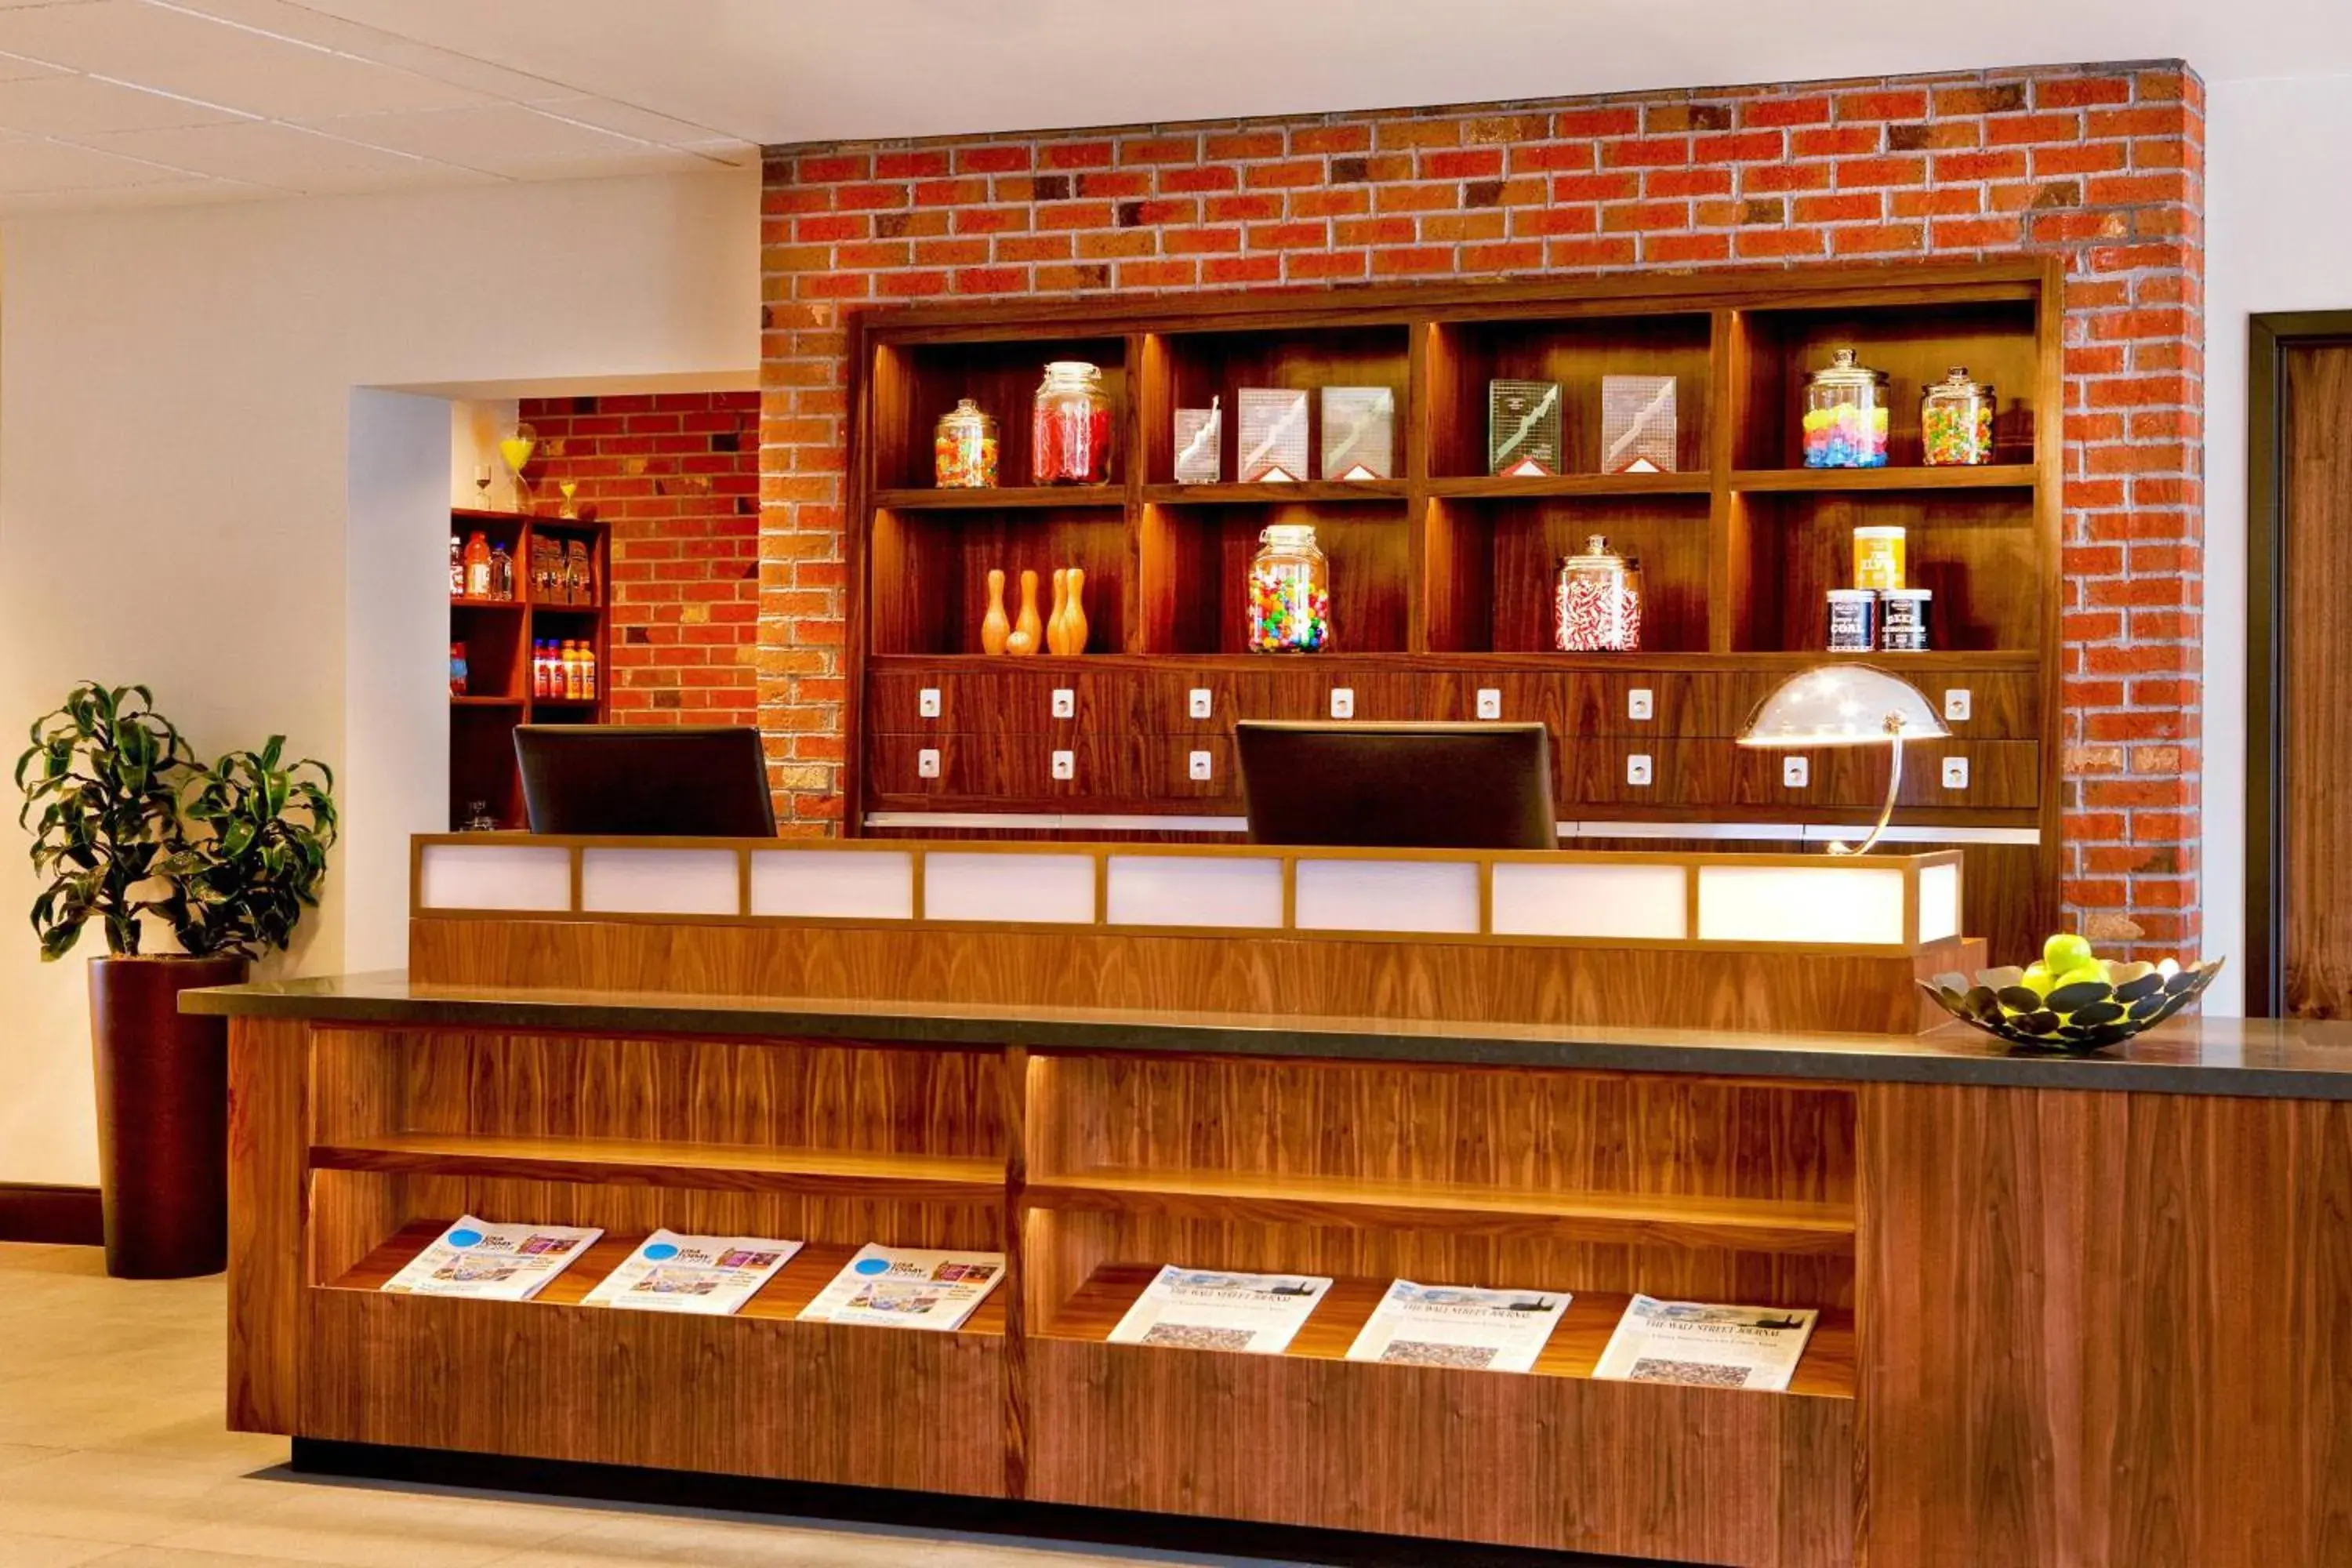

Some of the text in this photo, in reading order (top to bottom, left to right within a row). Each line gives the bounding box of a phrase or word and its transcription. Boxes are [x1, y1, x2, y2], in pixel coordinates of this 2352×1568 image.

[1831, 624, 1864, 633] COAL
[1452, 1307, 1487, 1316] STREET
[1646, 1319, 1780, 1337] THE WALL STREET JOURNAL
